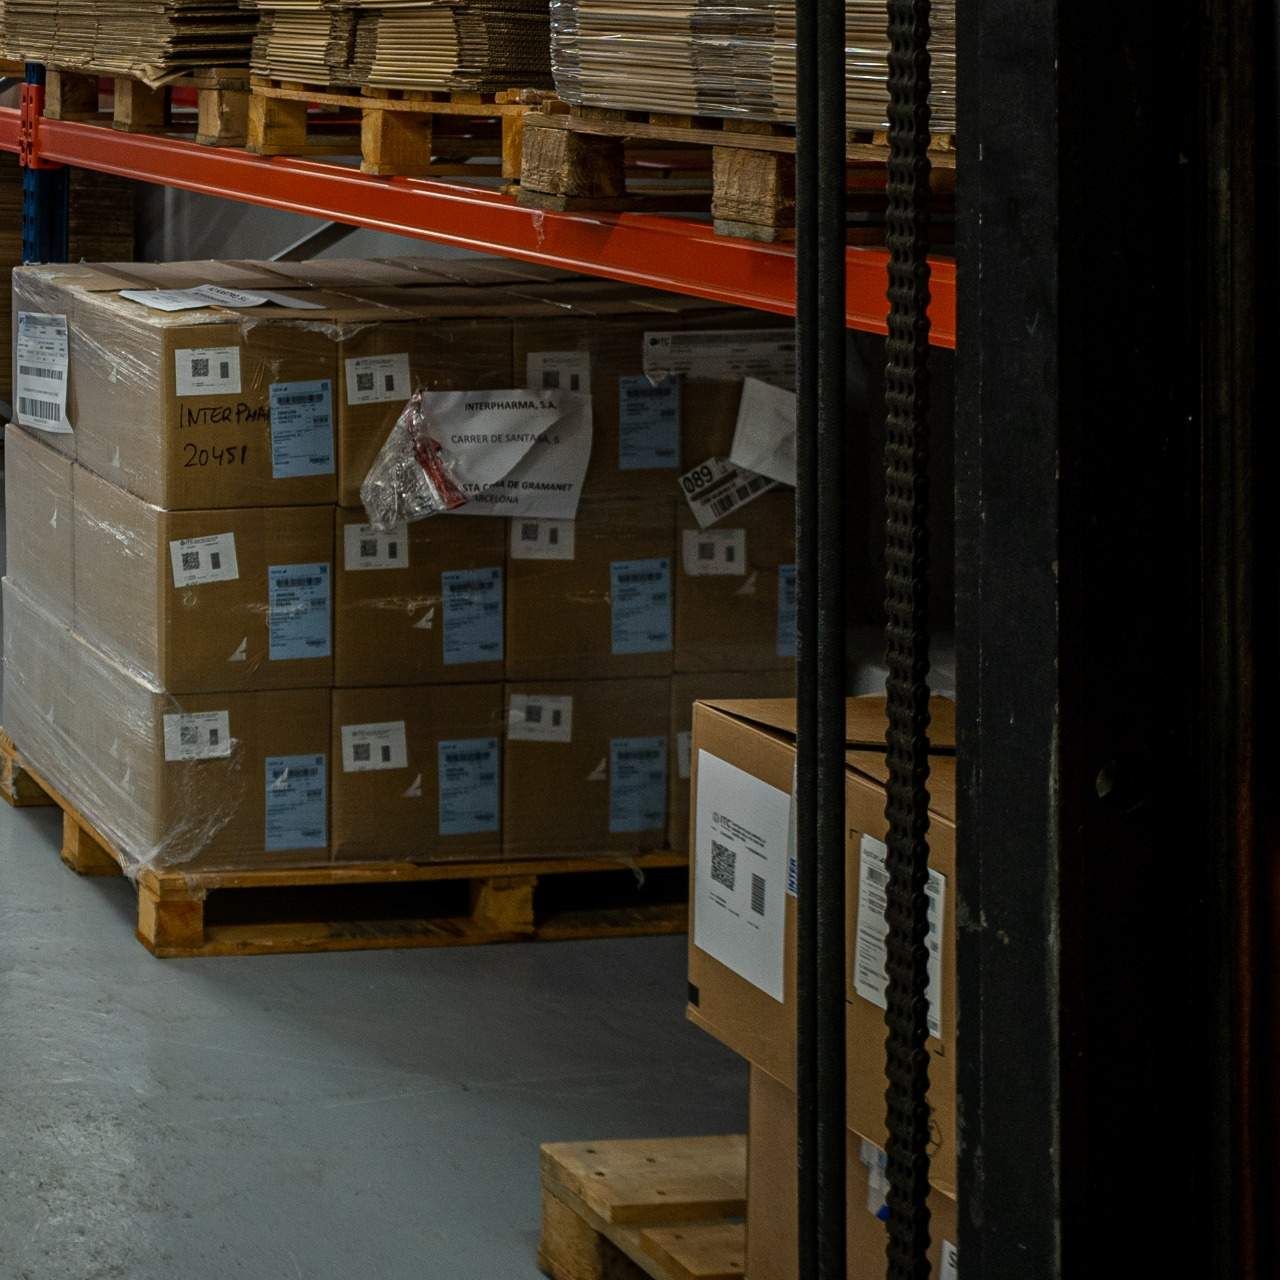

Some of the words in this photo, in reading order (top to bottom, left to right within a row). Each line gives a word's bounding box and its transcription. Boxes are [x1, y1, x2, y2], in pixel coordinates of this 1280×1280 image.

[465, 400, 539, 411] INTERPHARMA,
[540, 401, 557, 410] S.A.
[451, 434, 488, 444] CARRER
[490, 434, 502, 443] DE
[183, 443, 248, 468] 20451
[681, 465, 713, 494] 089
[462, 483, 480, 493] STA
[507, 480, 518, 489] DE
[521, 481, 574, 491] GRAMANET
